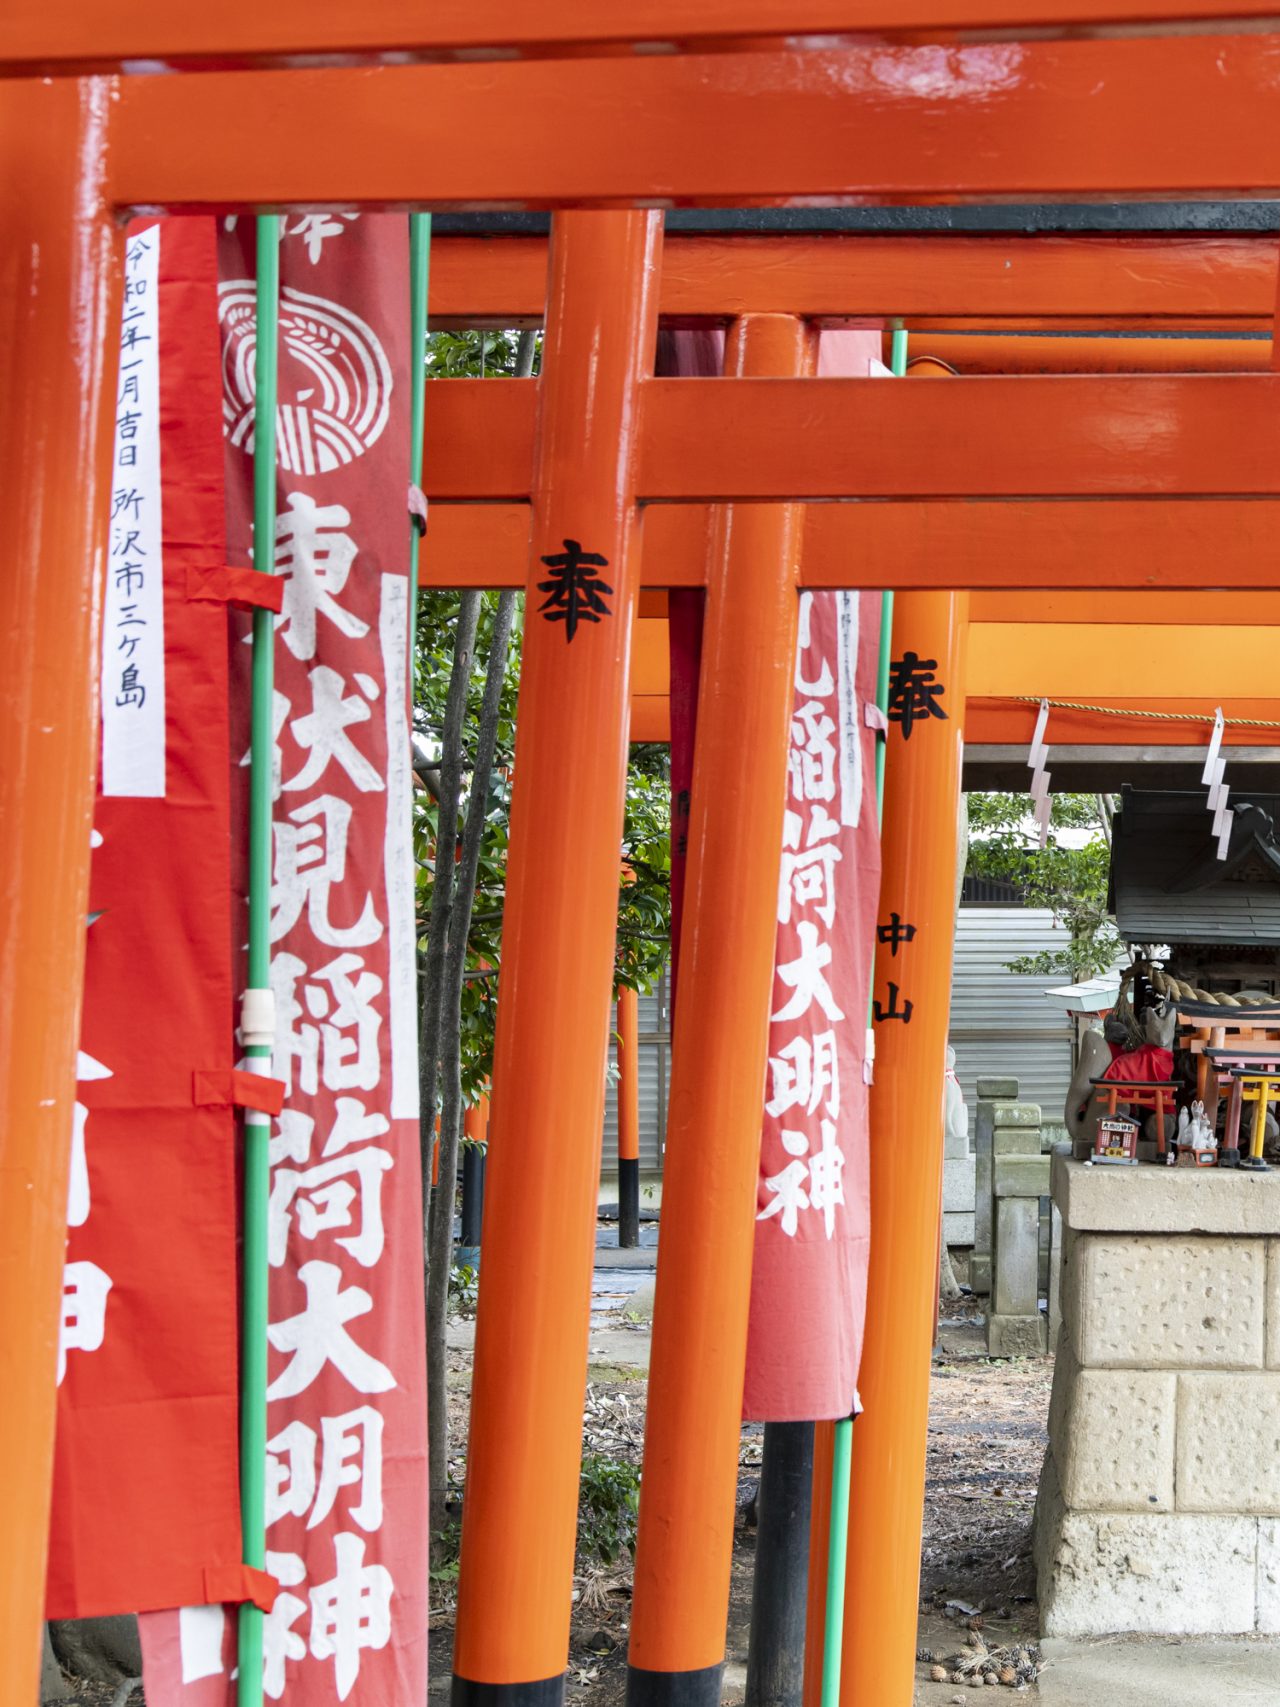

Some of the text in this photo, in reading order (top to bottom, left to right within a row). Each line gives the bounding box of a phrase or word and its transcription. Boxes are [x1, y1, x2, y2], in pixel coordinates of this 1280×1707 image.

[116, 238, 152, 467] 令和二年一月吉日
[537, 539, 613, 644] 奉
[888, 651, 949, 742] 奉
[872, 911, 917, 1024] 中山
